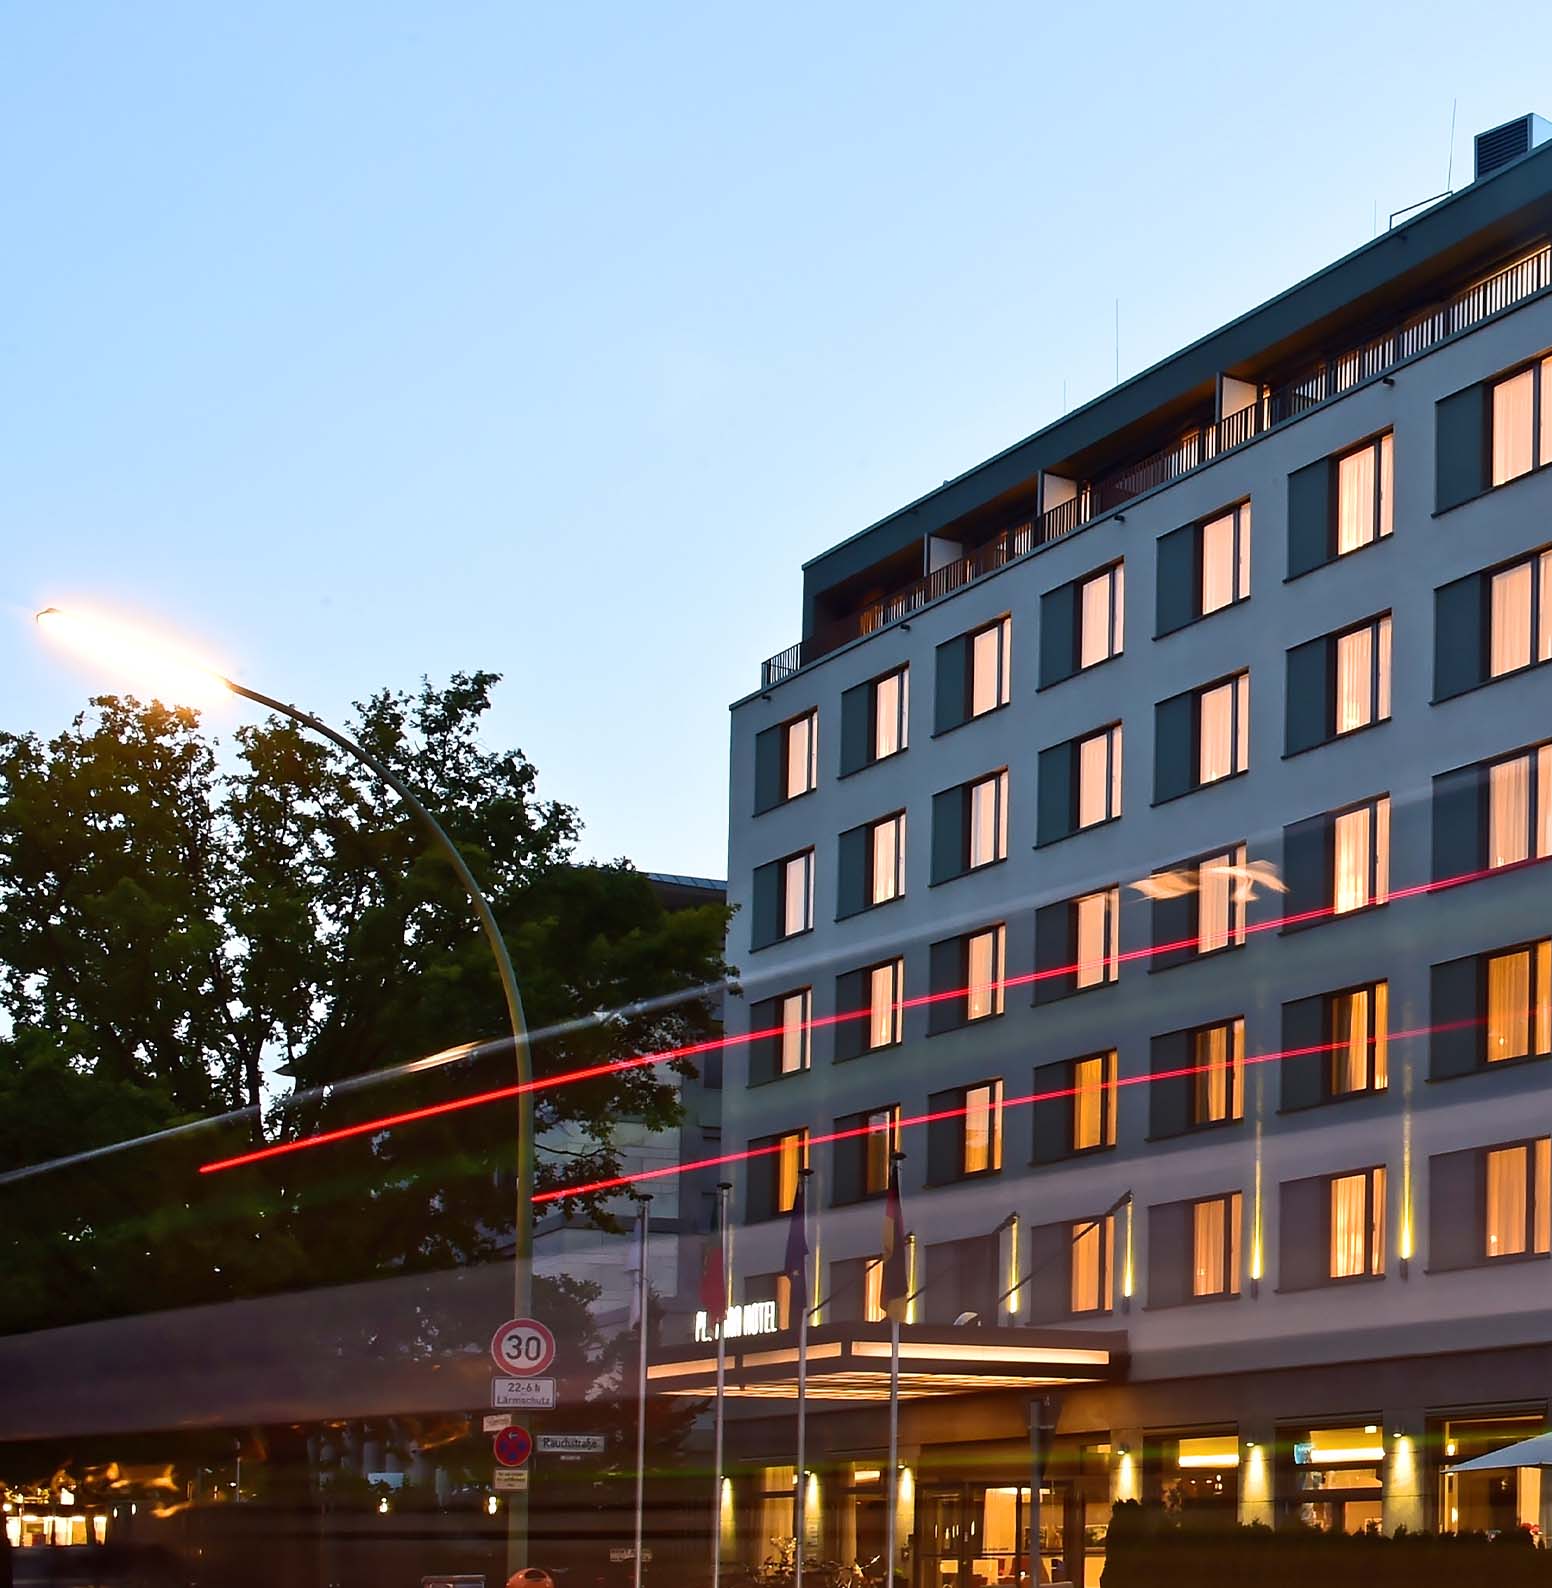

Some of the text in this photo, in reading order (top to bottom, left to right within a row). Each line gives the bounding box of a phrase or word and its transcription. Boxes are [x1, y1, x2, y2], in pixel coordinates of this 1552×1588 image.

[743, 1300, 778, 1336] HOTEL
[505, 1334, 541, 1361] 30
[507, 1382, 533, 1393] 22-6
